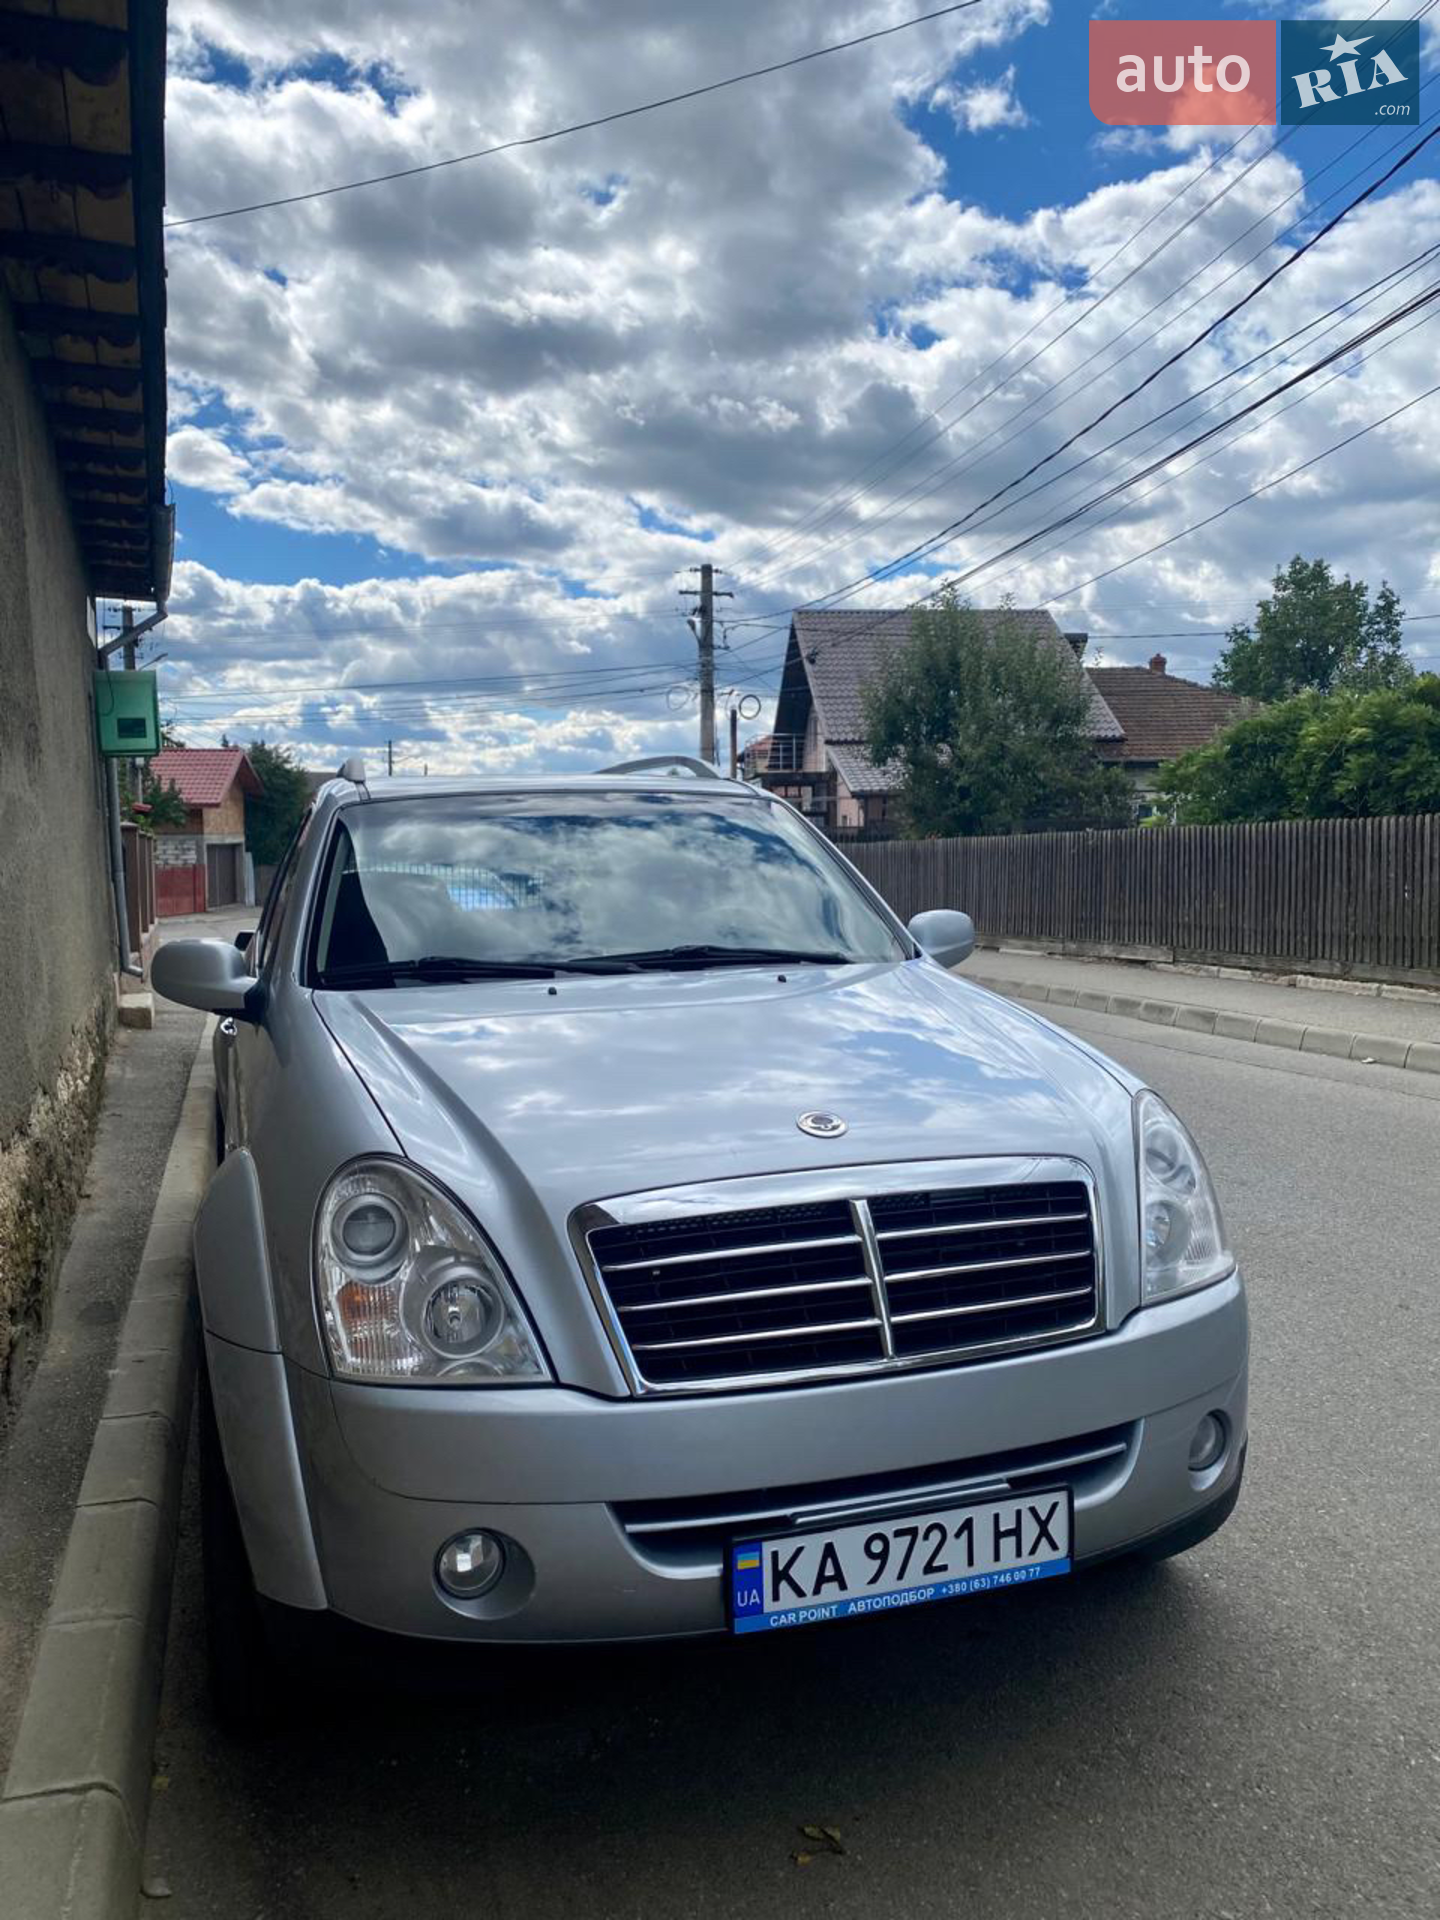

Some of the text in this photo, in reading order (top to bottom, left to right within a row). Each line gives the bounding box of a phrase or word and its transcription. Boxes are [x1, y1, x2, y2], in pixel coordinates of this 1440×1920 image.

[771, 1500, 1062, 1602] KA 9721 HX
[737, 1588, 760, 1607] UA
[770, 1613, 797, 1627] CAR
[799, 1605, 838, 1623] POINT
[848, 1587, 935, 1615] АВТОПОДБОР
[941, 1582, 967, 1595] +380
[969, 1577, 990, 1592] (63)
[993, 1573, 1012, 1586] 746
[1028, 1567, 1041, 1578] 77
